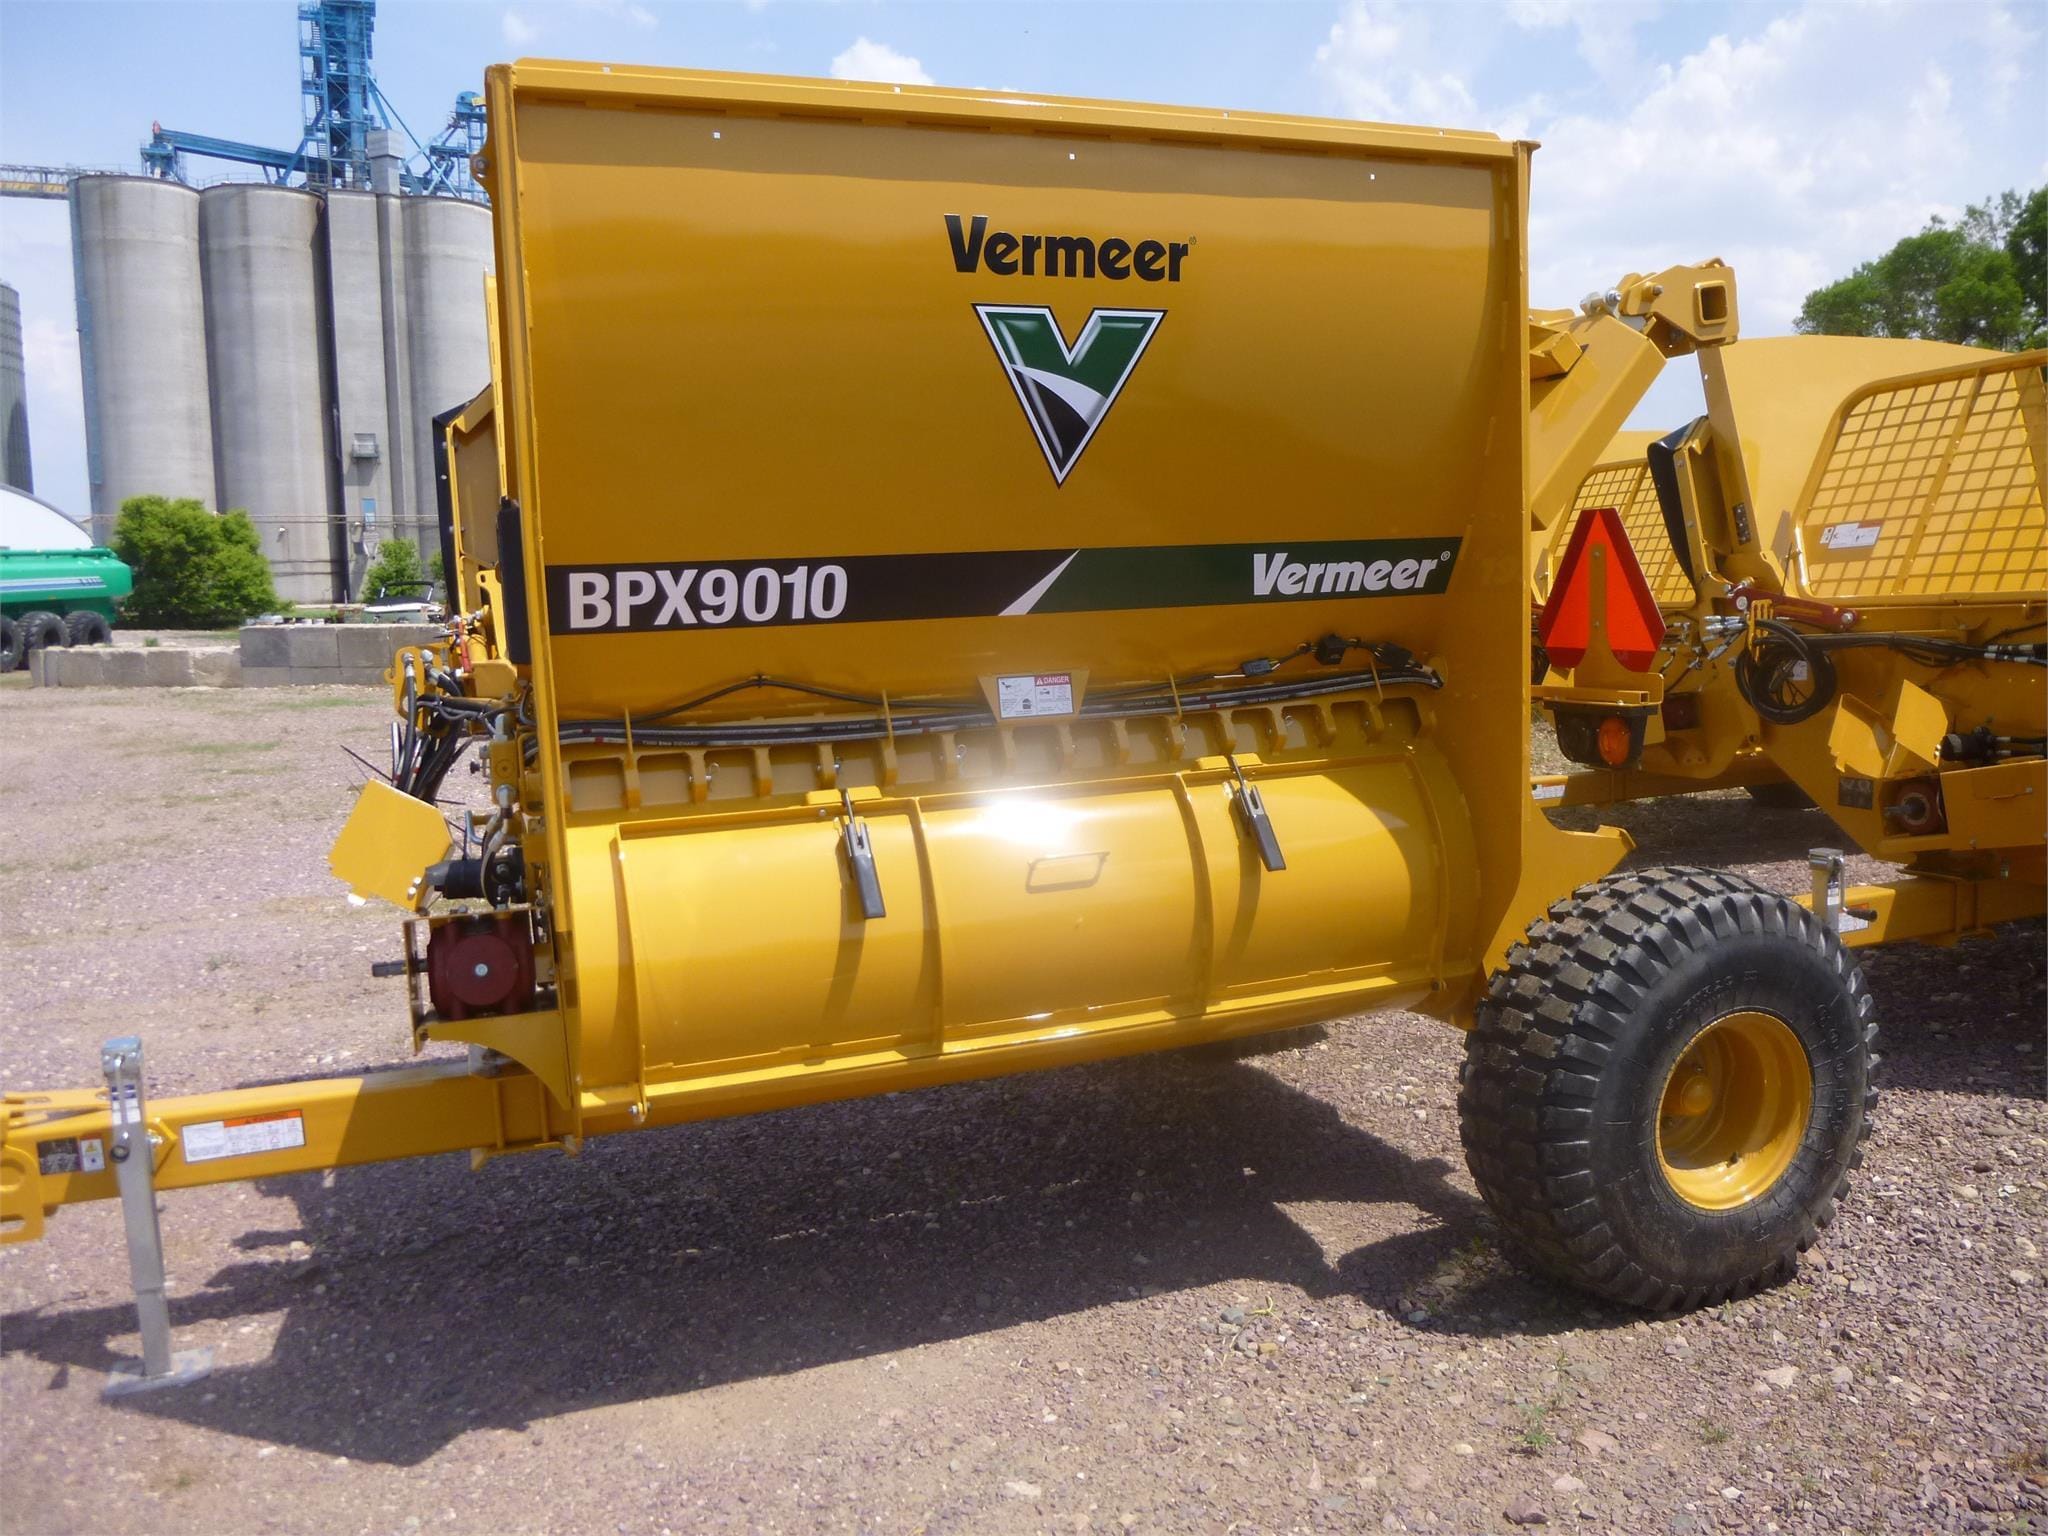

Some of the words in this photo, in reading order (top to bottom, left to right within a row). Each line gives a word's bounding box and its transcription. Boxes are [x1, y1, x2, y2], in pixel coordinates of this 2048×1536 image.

[944, 213, 1189, 282] Vermeer
[568, 564, 848, 629] BPX9010
[1043, 675, 1070, 685] DANGER
